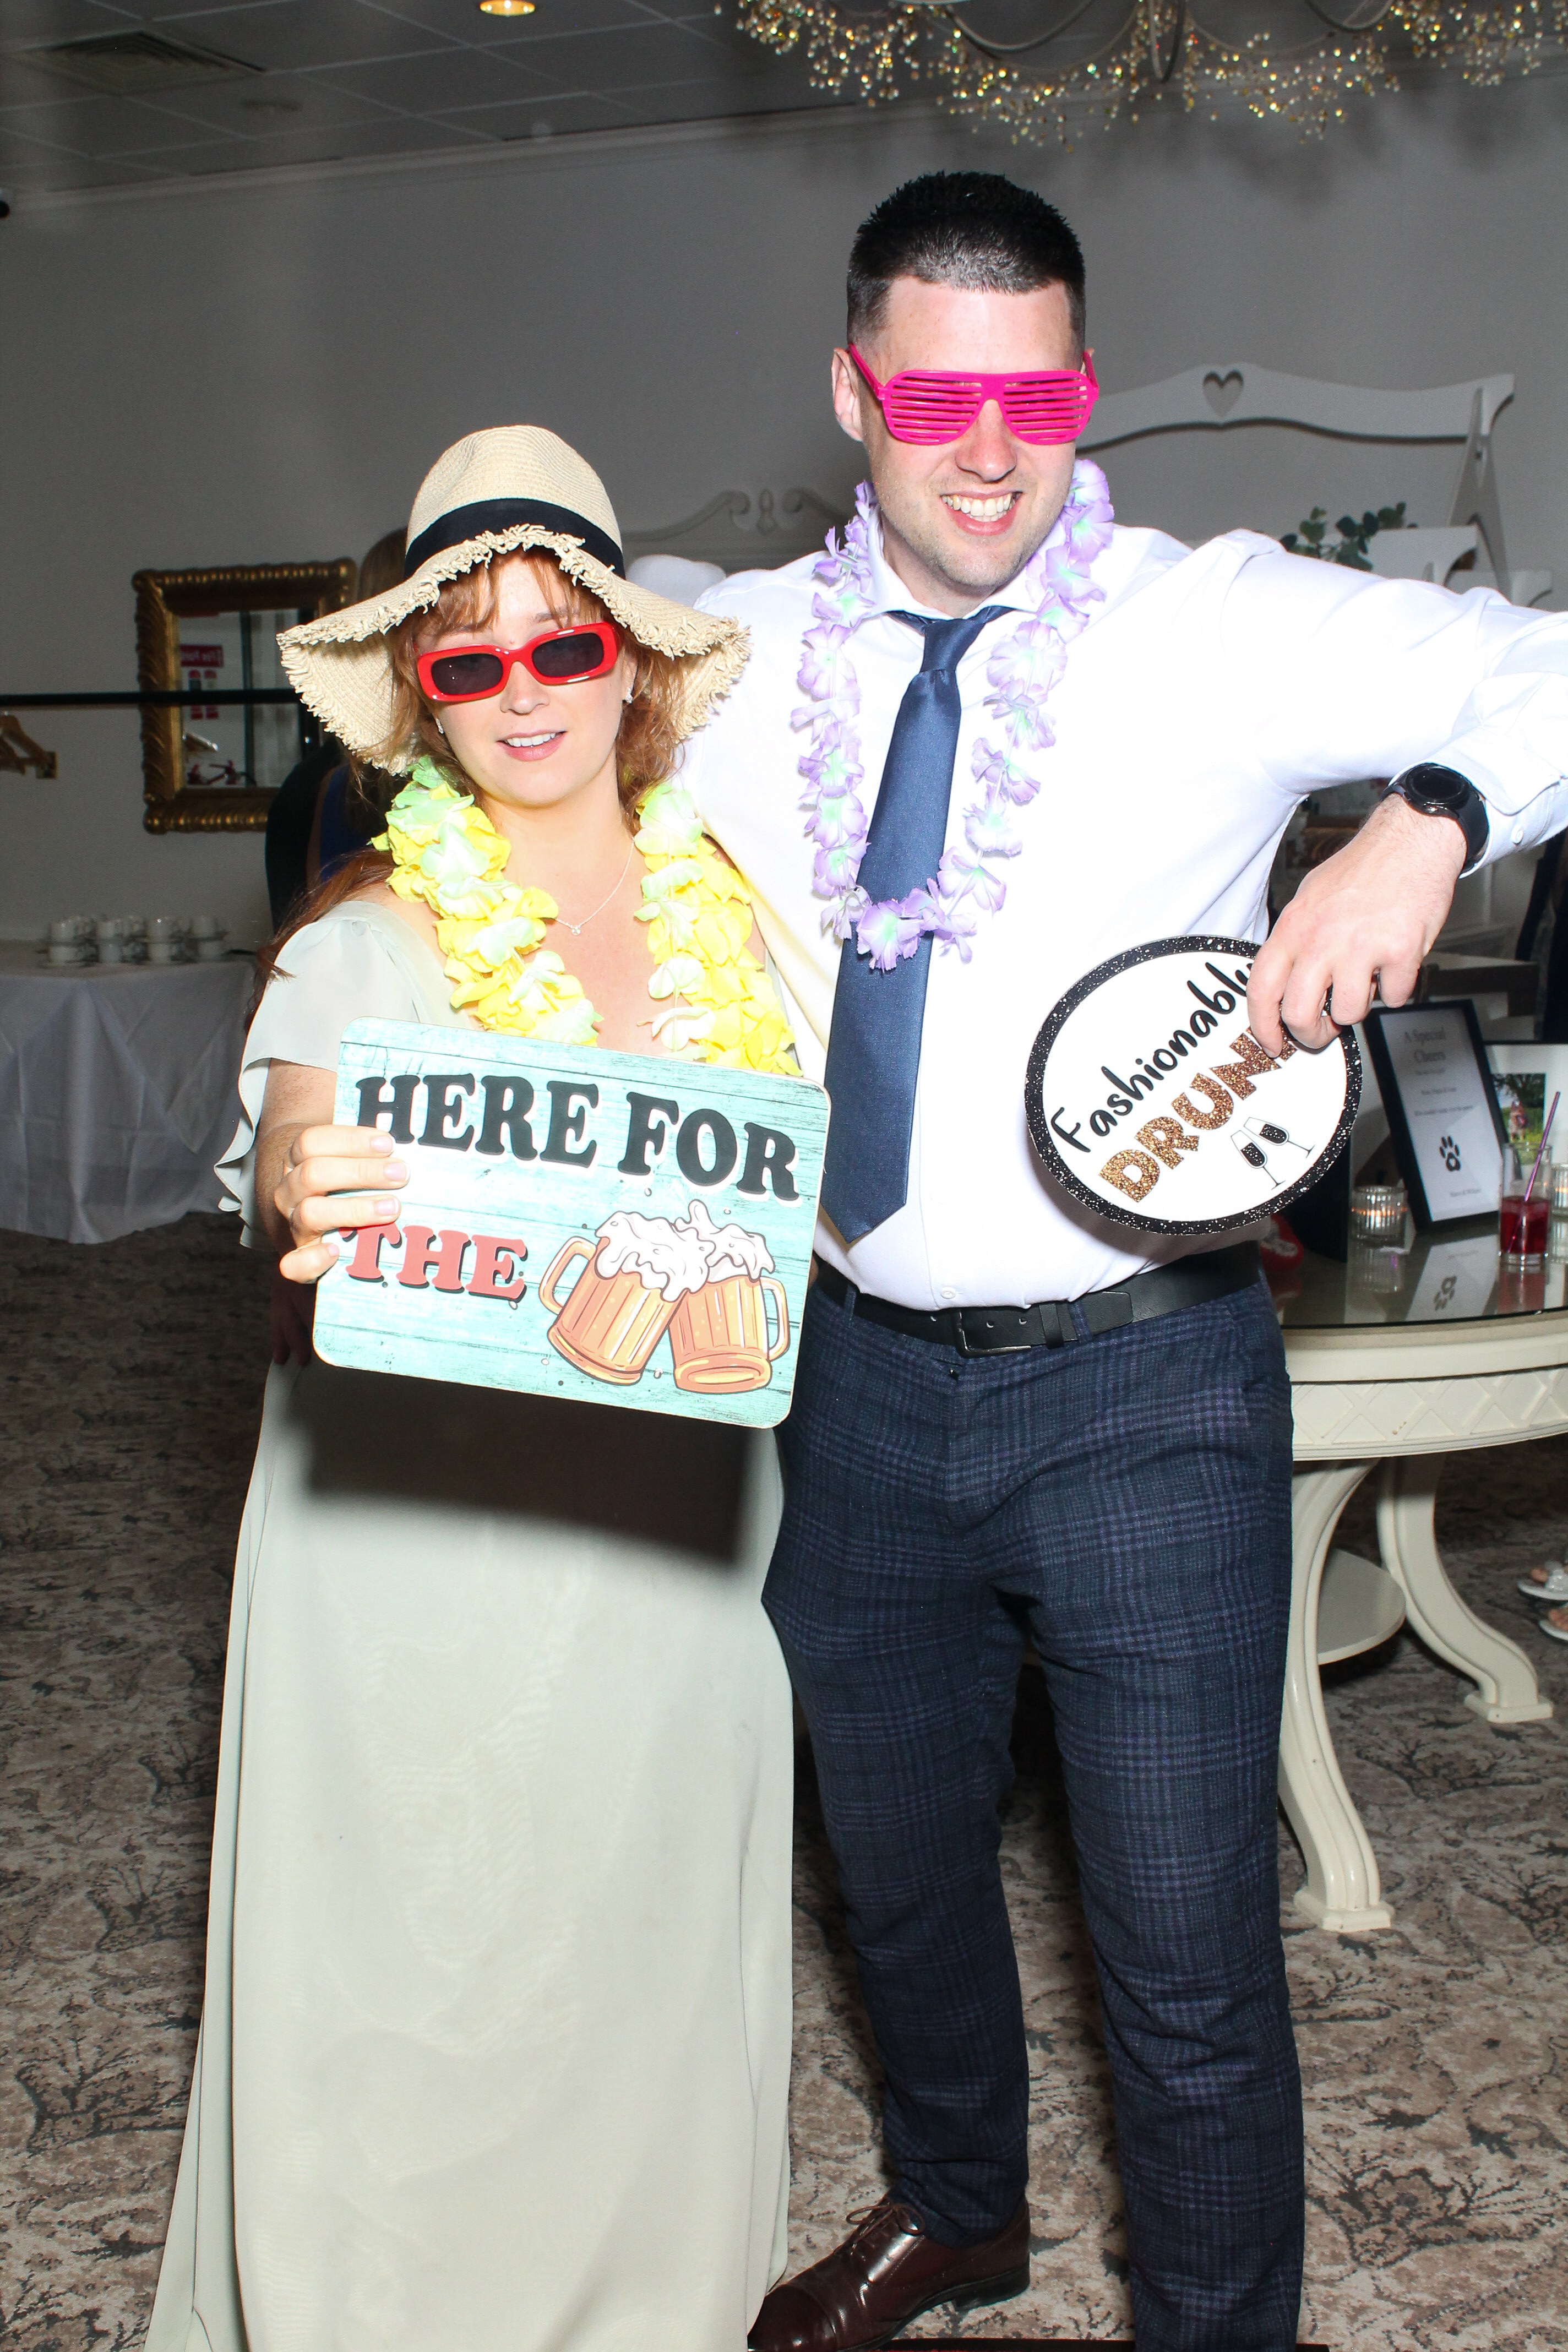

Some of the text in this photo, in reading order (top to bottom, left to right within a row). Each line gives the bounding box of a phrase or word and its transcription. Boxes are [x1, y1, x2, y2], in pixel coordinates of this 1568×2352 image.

[1050, 962, 1254, 1153] Fashionabl
[1098, 1024, 1298, 1202] DRUN
[355, 1072, 801, 1201] HERE FOR
[338, 1222, 528, 1303] THE
